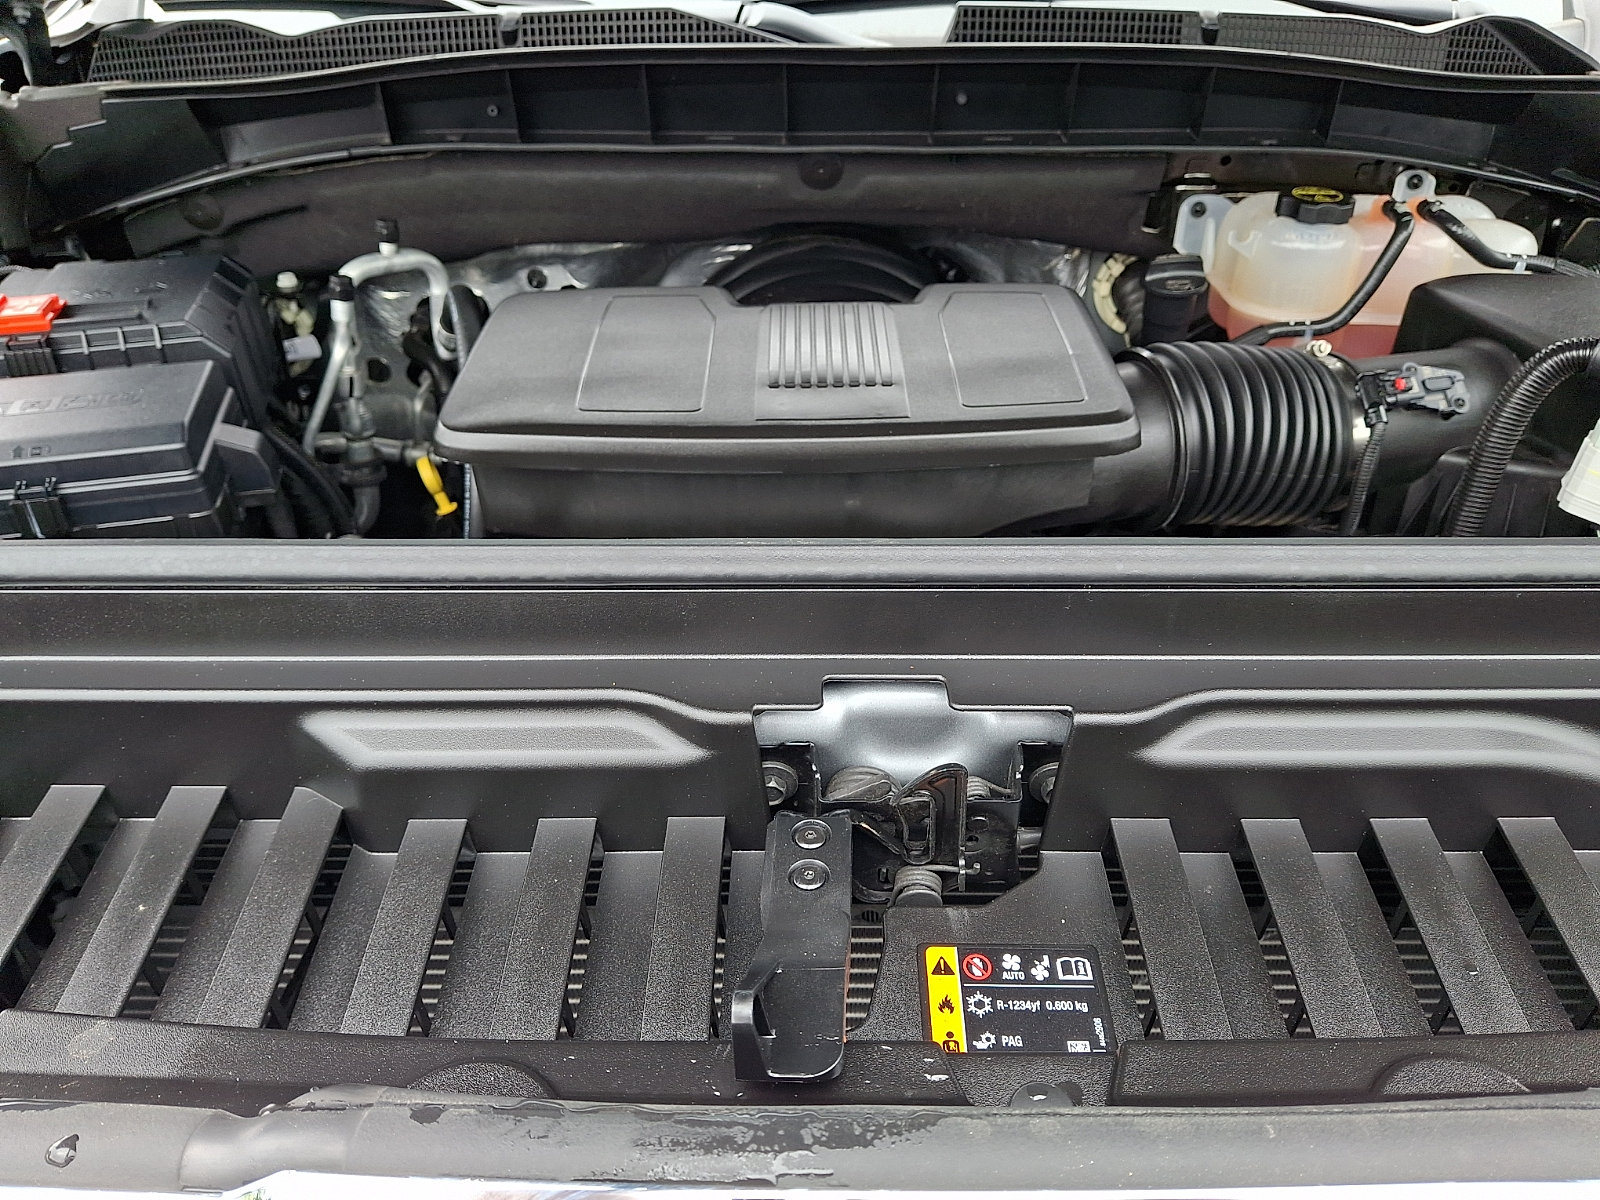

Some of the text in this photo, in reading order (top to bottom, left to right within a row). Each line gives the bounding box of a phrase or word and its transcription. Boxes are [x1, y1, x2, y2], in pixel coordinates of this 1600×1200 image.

[1002, 971, 1025, 981] AUTO
[996, 1000, 1089, 1013] R-1234yf 0.600 kg
[1001, 1035, 1024, 1047] PAG
